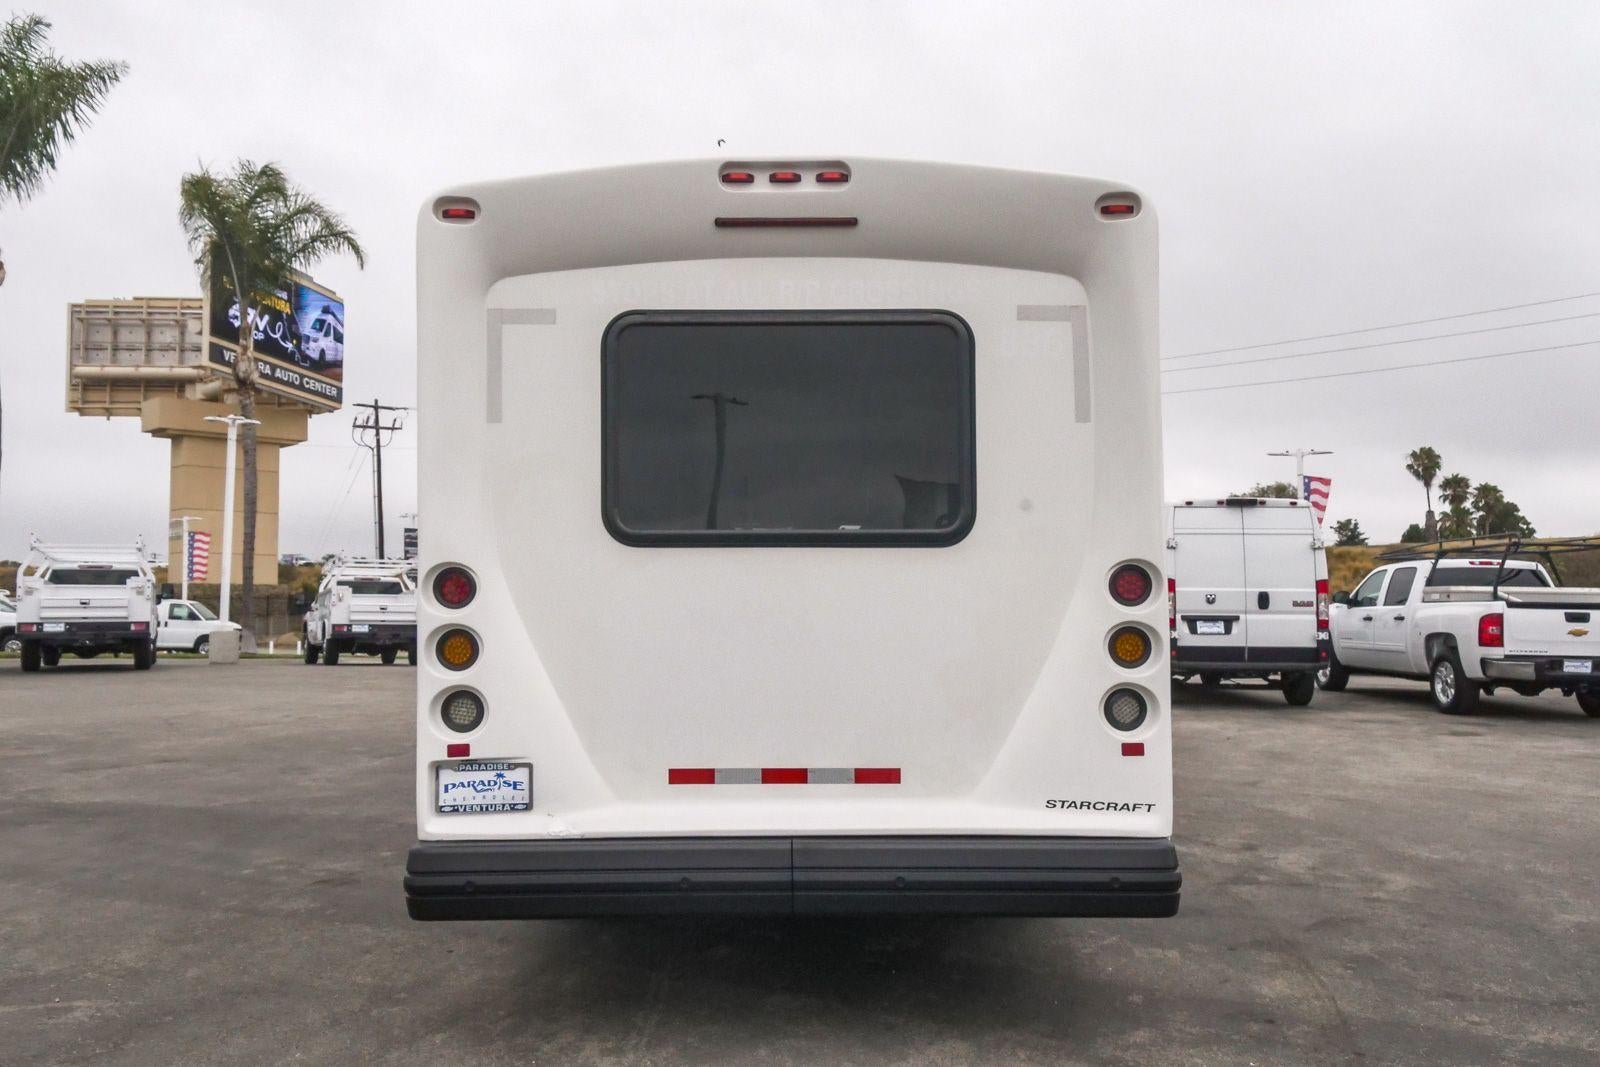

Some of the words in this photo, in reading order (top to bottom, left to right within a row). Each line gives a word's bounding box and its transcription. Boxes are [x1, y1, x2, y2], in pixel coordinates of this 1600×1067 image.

[223, 349, 271, 375] VERA
[274, 367, 300, 385] AUTO
[303, 377, 338, 397] CENTER
[459, 763, 509, 771] PARADISE
[443, 773, 525, 793] PARADISE
[458, 803, 511, 812] VENTURA
[1045, 799, 1156, 812] STARCRAFT
